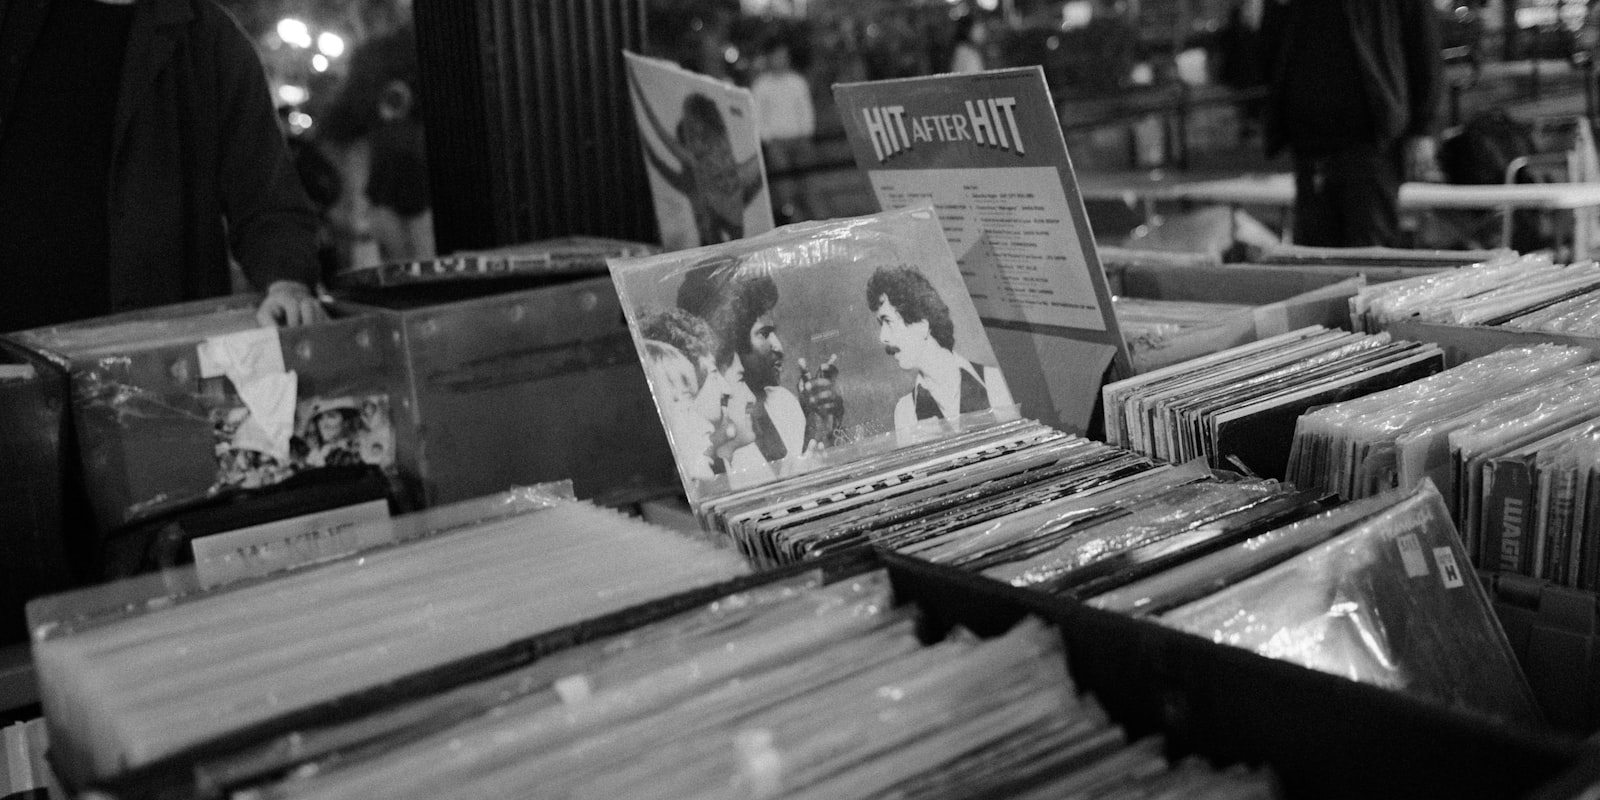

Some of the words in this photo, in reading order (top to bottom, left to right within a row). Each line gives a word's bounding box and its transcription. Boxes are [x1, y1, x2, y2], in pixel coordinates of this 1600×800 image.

[862, 105, 912, 162] HIT
[912, 114, 971, 142] AFTER
[964, 97, 1025, 156] HIT
